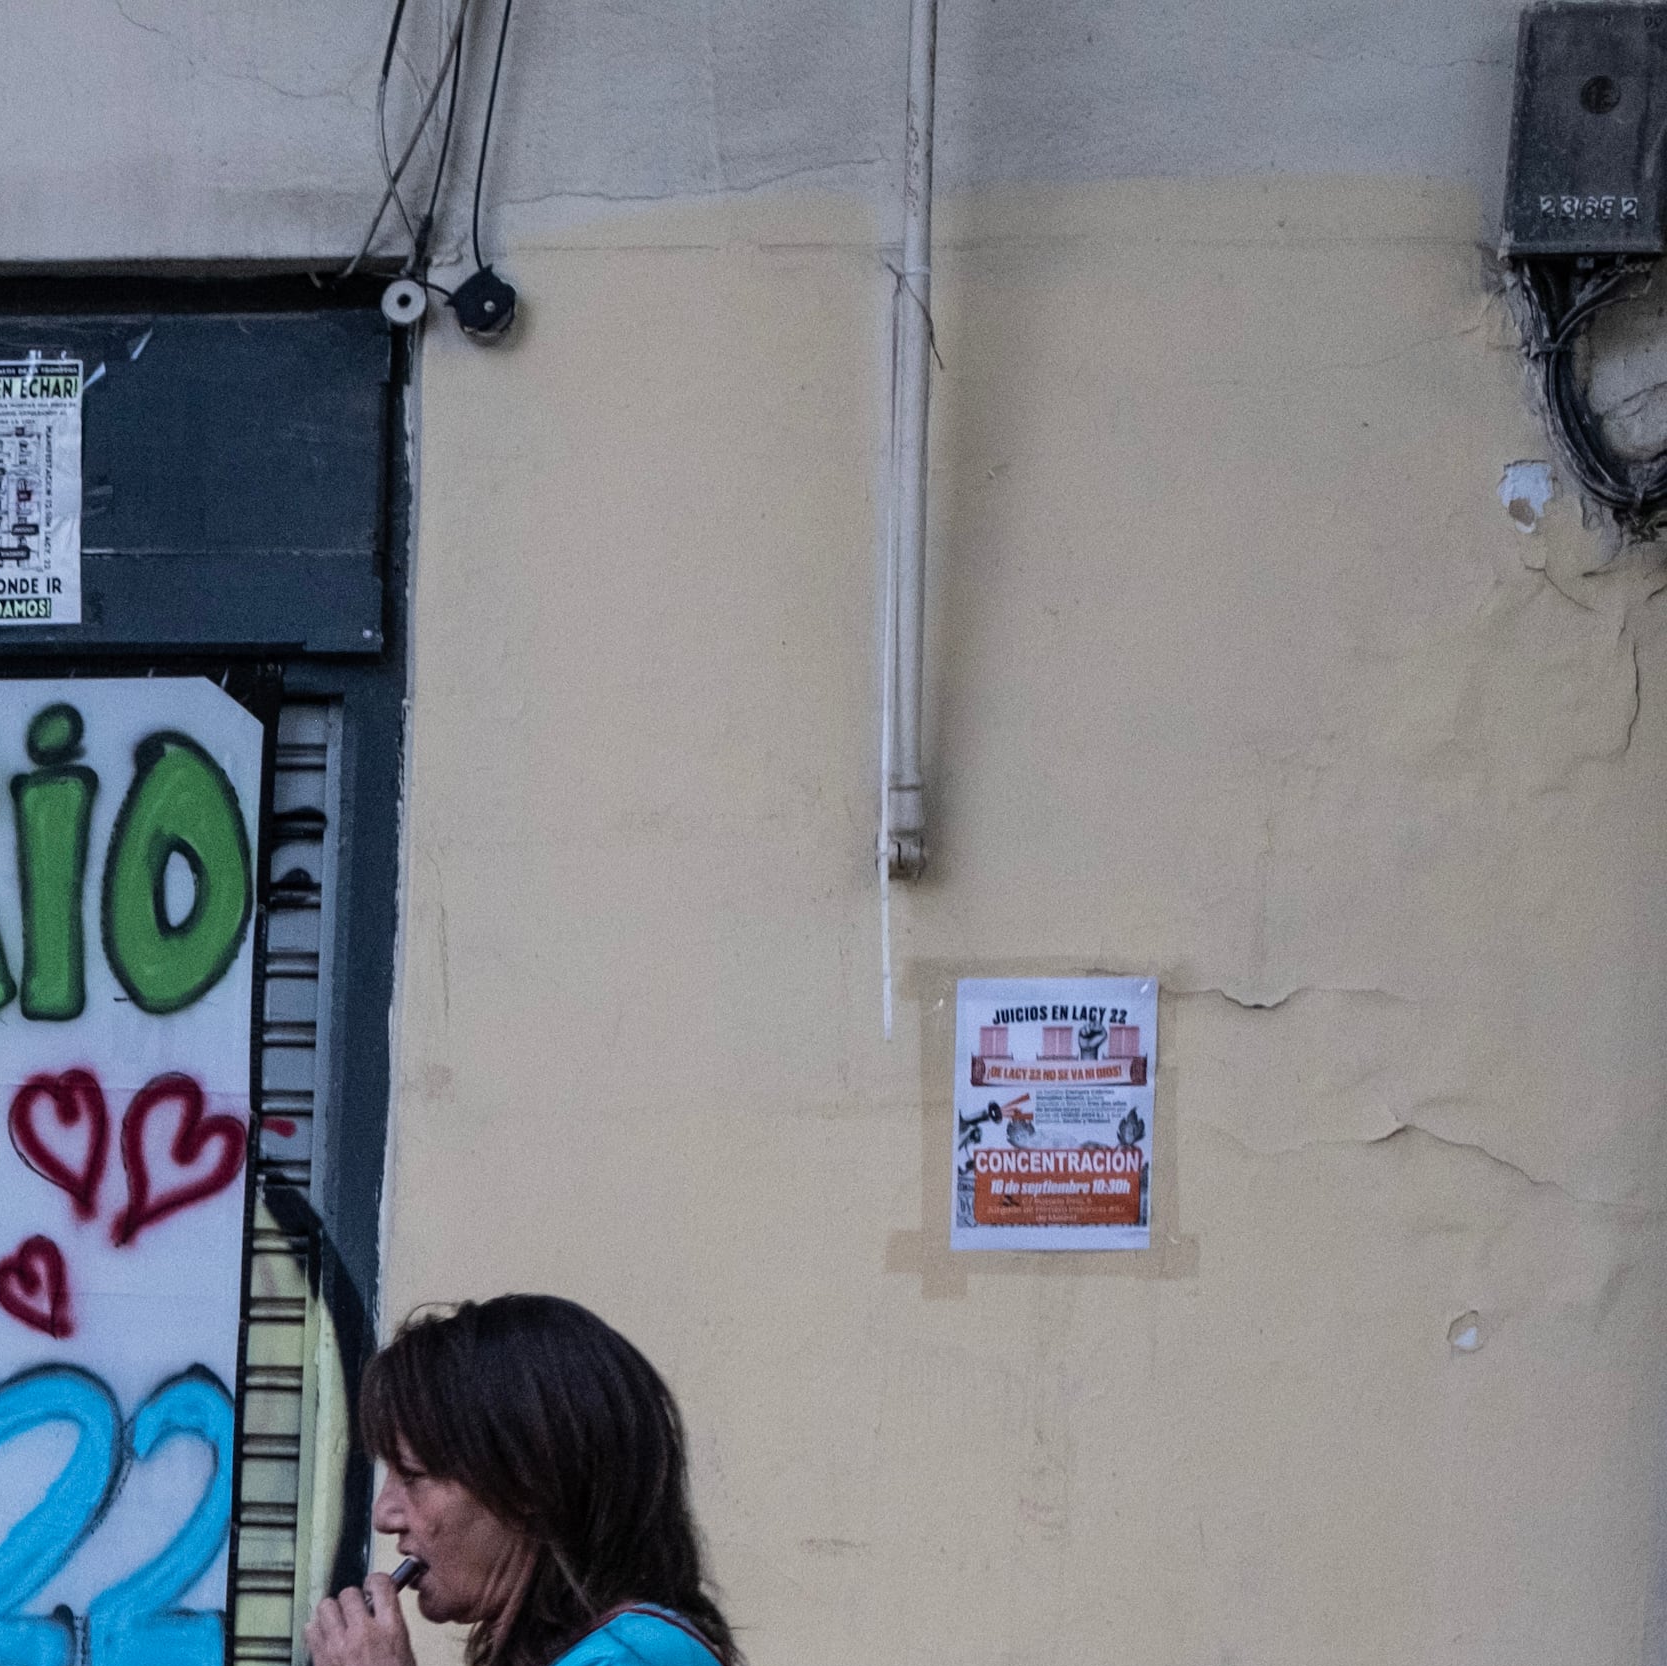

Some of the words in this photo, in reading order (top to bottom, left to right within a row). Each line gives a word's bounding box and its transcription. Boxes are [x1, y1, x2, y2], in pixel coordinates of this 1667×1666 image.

[20, 378, 78, 399] ECHAR!
[46, 577, 62, 594] IR
[993, 1005, 1048, 1025] JUICIOS
[1051, 1005, 1069, 1020] EN
[1072, 1005, 1106, 1024] LACY
[1109, 1008, 1128, 1024] 22
[1004, 1067, 1027, 1080] LACY
[1070, 1068, 1083, 1080] VA
[975, 1149, 1139, 1174] CONCENTRACIÓN
[1005, 1179, 1019, 1194] de
[1021, 1180, 1090, 1196] septiembre
